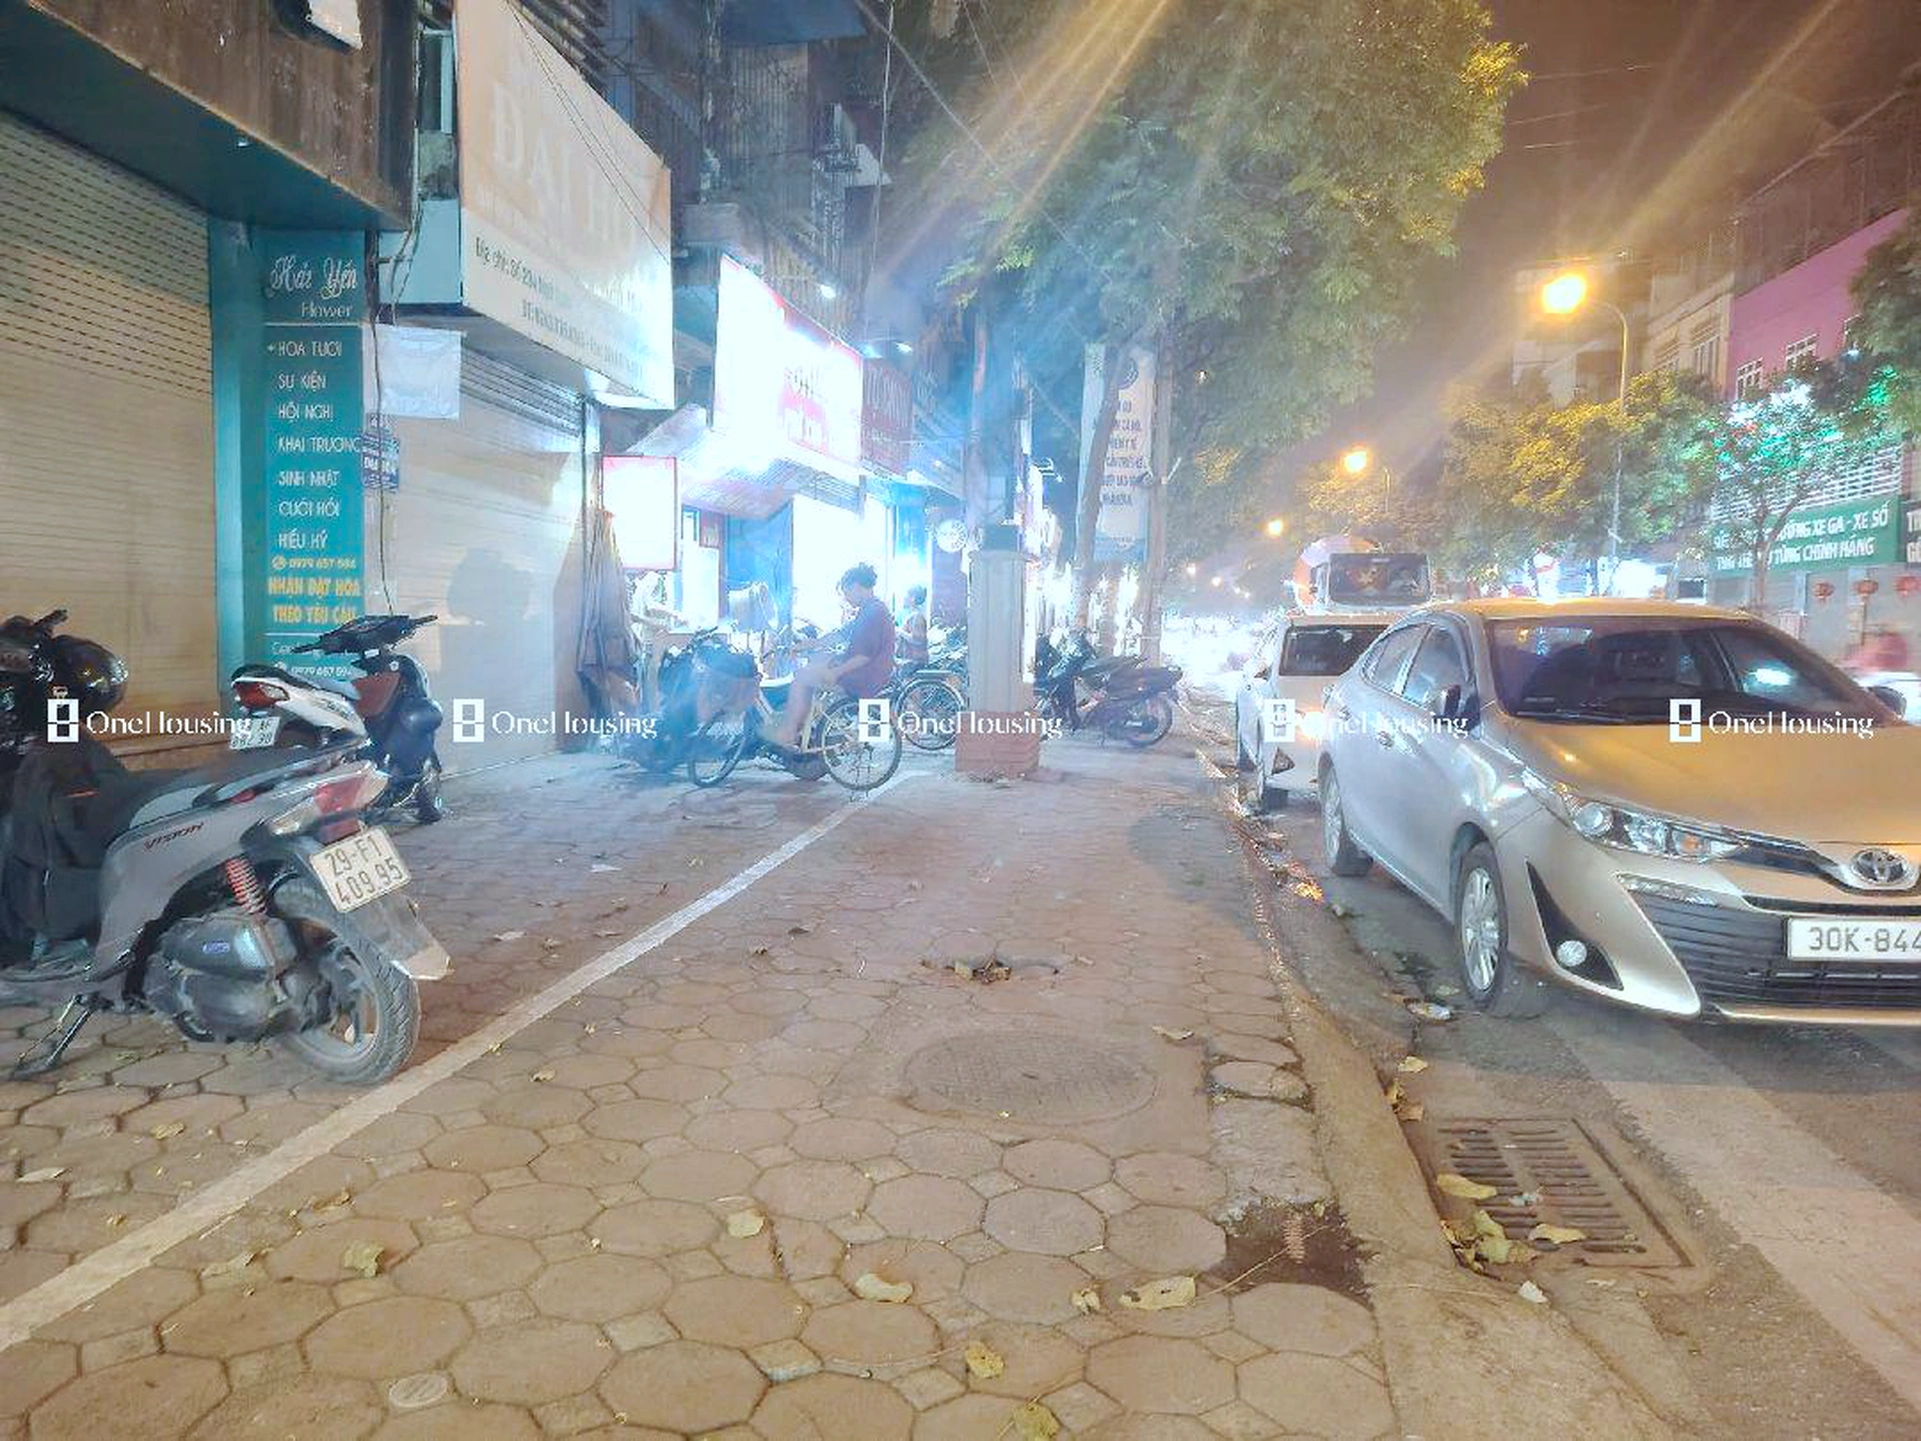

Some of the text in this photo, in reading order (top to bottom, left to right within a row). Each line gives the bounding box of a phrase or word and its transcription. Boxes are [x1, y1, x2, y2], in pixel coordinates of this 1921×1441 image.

[301, 301, 354, 318] Flower
[279, 341, 305, 357] HOA
[300, 368, 327, 393] KIỆN
[278, 401, 334, 424] HỘI NGHỊ
[278, 436, 305, 452] KHAI
[278, 468, 340, 489] SINH NHẬT
[1812, 518, 1827, 537] XE
[1828, 515, 1846, 535] GA
[1851, 510, 1869, 531] XE
[1870, 499, 1890, 529] SỐ
[1803, 538, 1838, 561] CHÍNH
[268, 576, 361, 599] NHẬN ĐẶT HOA
[274, 604, 301, 623] THEO
[305, 601, 329, 624] YÊU
[325, 835, 382, 876] 29-F1
[1808, 925, 1921, 953] 30K-844
